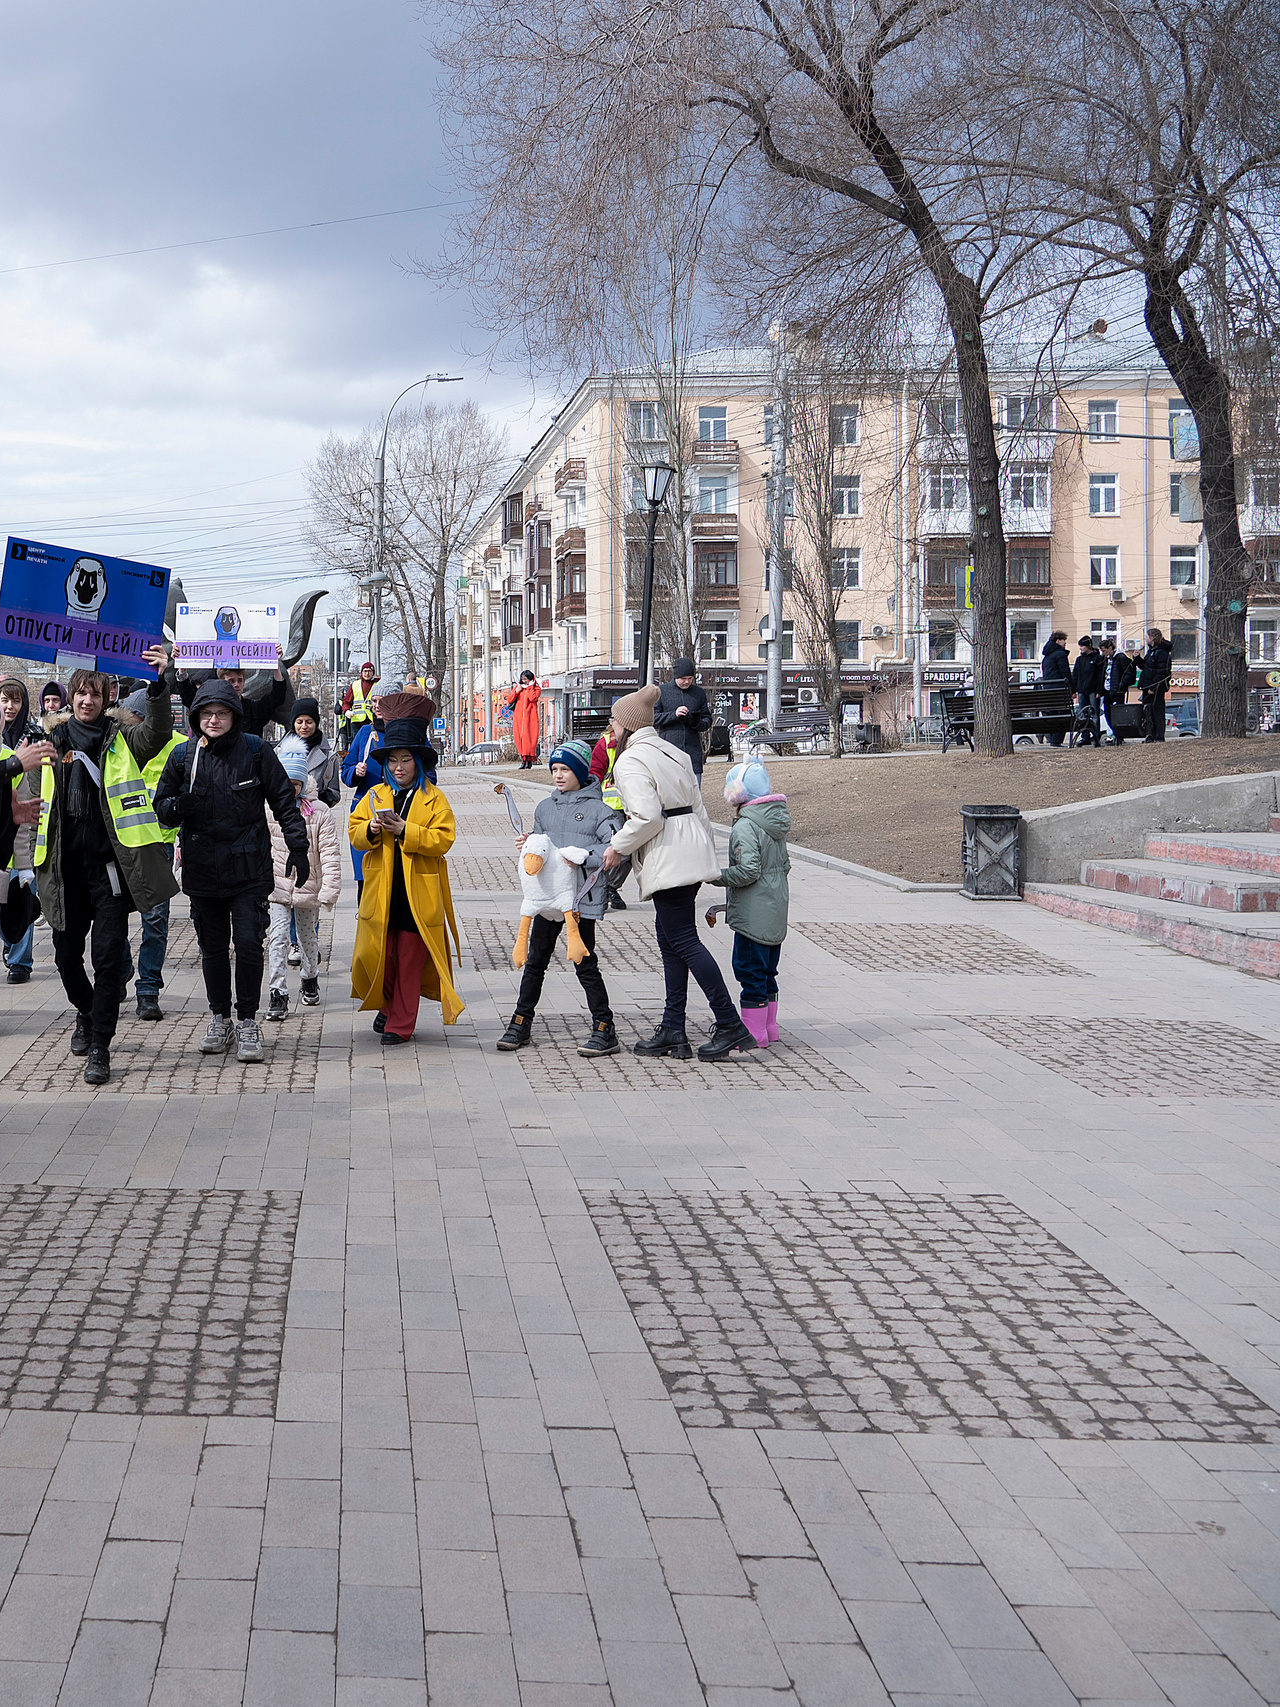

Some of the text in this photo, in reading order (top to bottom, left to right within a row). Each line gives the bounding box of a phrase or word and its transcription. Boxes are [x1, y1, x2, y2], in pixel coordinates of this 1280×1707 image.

[27, 546, 46, 554] ЦЕНТР
[26, 556, 48, 565] ПЕЧАТИ
[5, 614, 152, 658] ОТПУСТИ ГУСЕЙ!!!
[181, 644, 272, 657] ОТПУСТИ ГУСЕЙ!!!
[1169, 677, 1199, 687] ОФЕЙ
